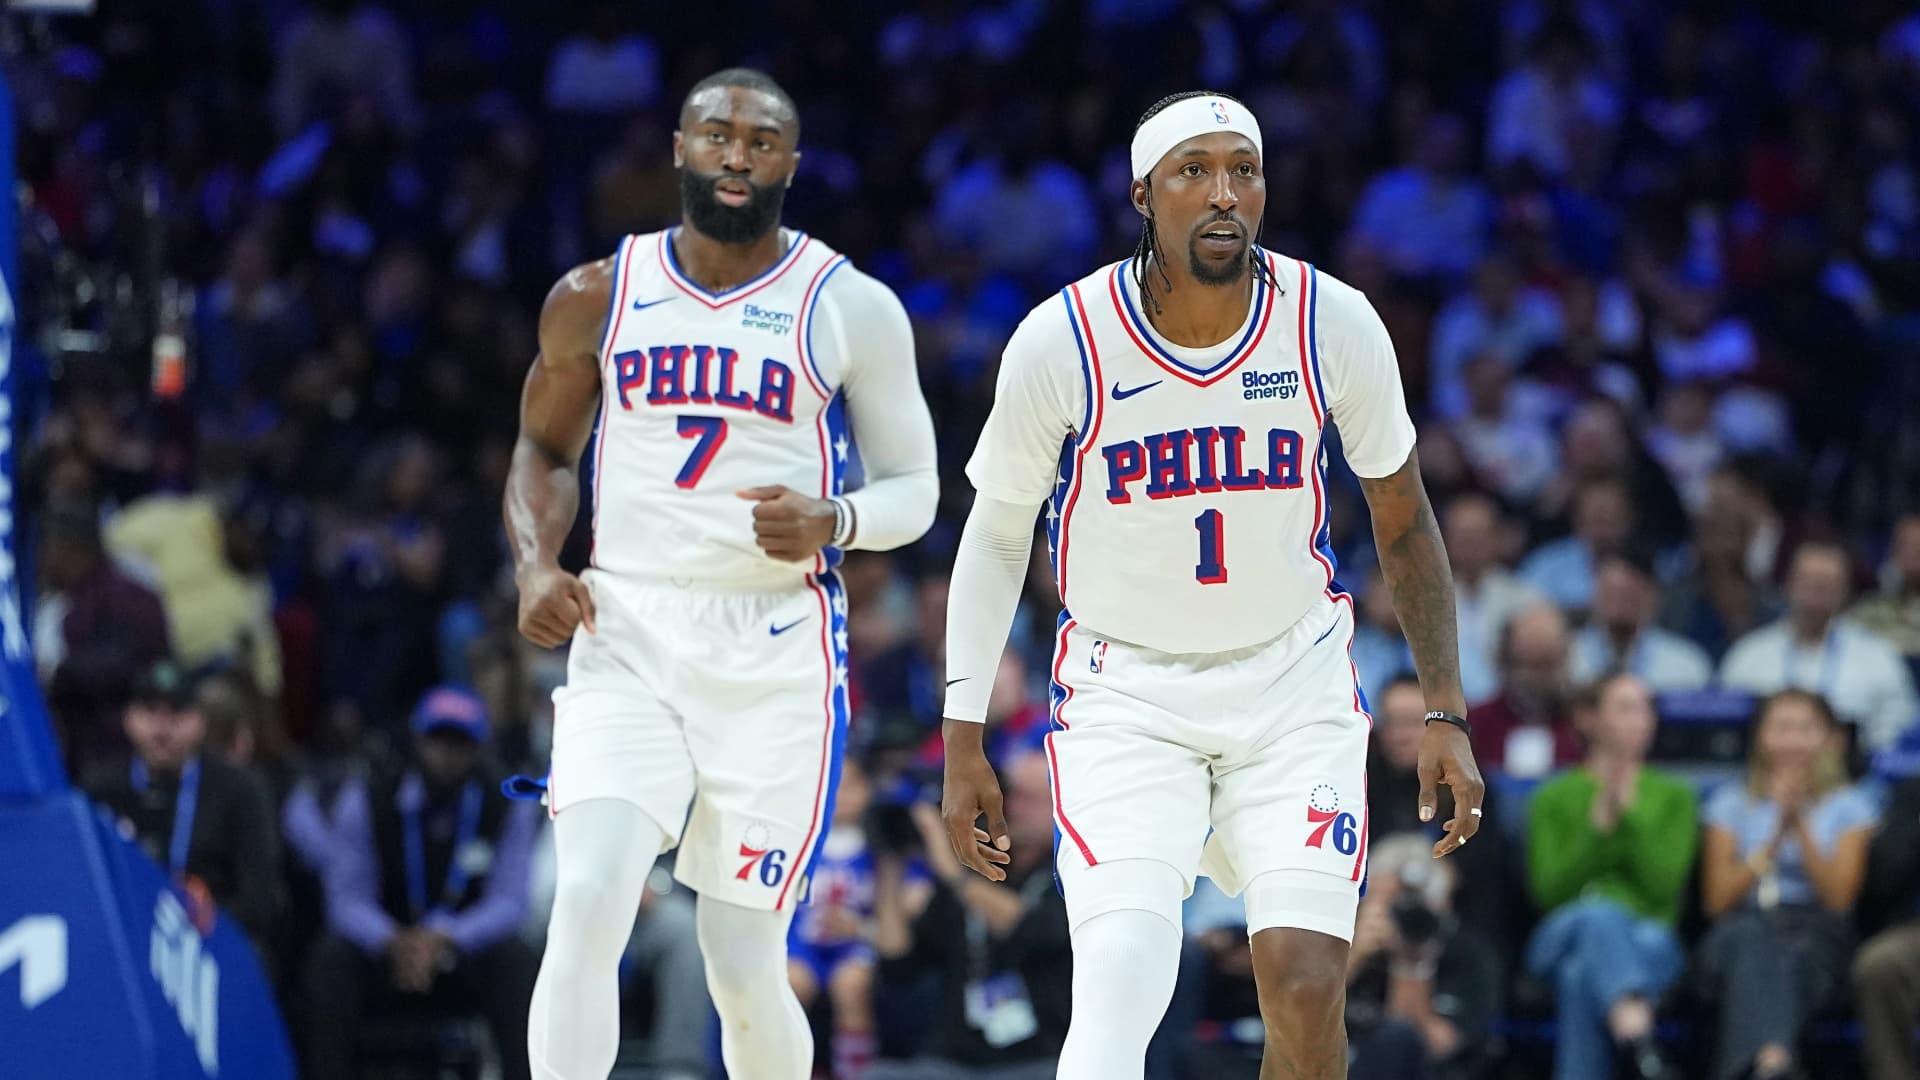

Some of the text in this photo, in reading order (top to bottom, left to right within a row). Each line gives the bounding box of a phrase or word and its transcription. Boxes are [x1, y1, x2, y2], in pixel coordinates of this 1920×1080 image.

[742, 319, 792, 336] energy
[744, 304, 793, 324] Bloom
[614, 345, 796, 424] PHILA
[1242, 370, 1298, 388] Bloom
[1243, 384, 1298, 400] energy
[674, 415, 728, 489] 7
[1102, 426, 1304, 504] PHILA
[1195, 508, 1228, 585] 1
[1305, 804, 1357, 856] 76
[735, 841, 786, 887] 76
